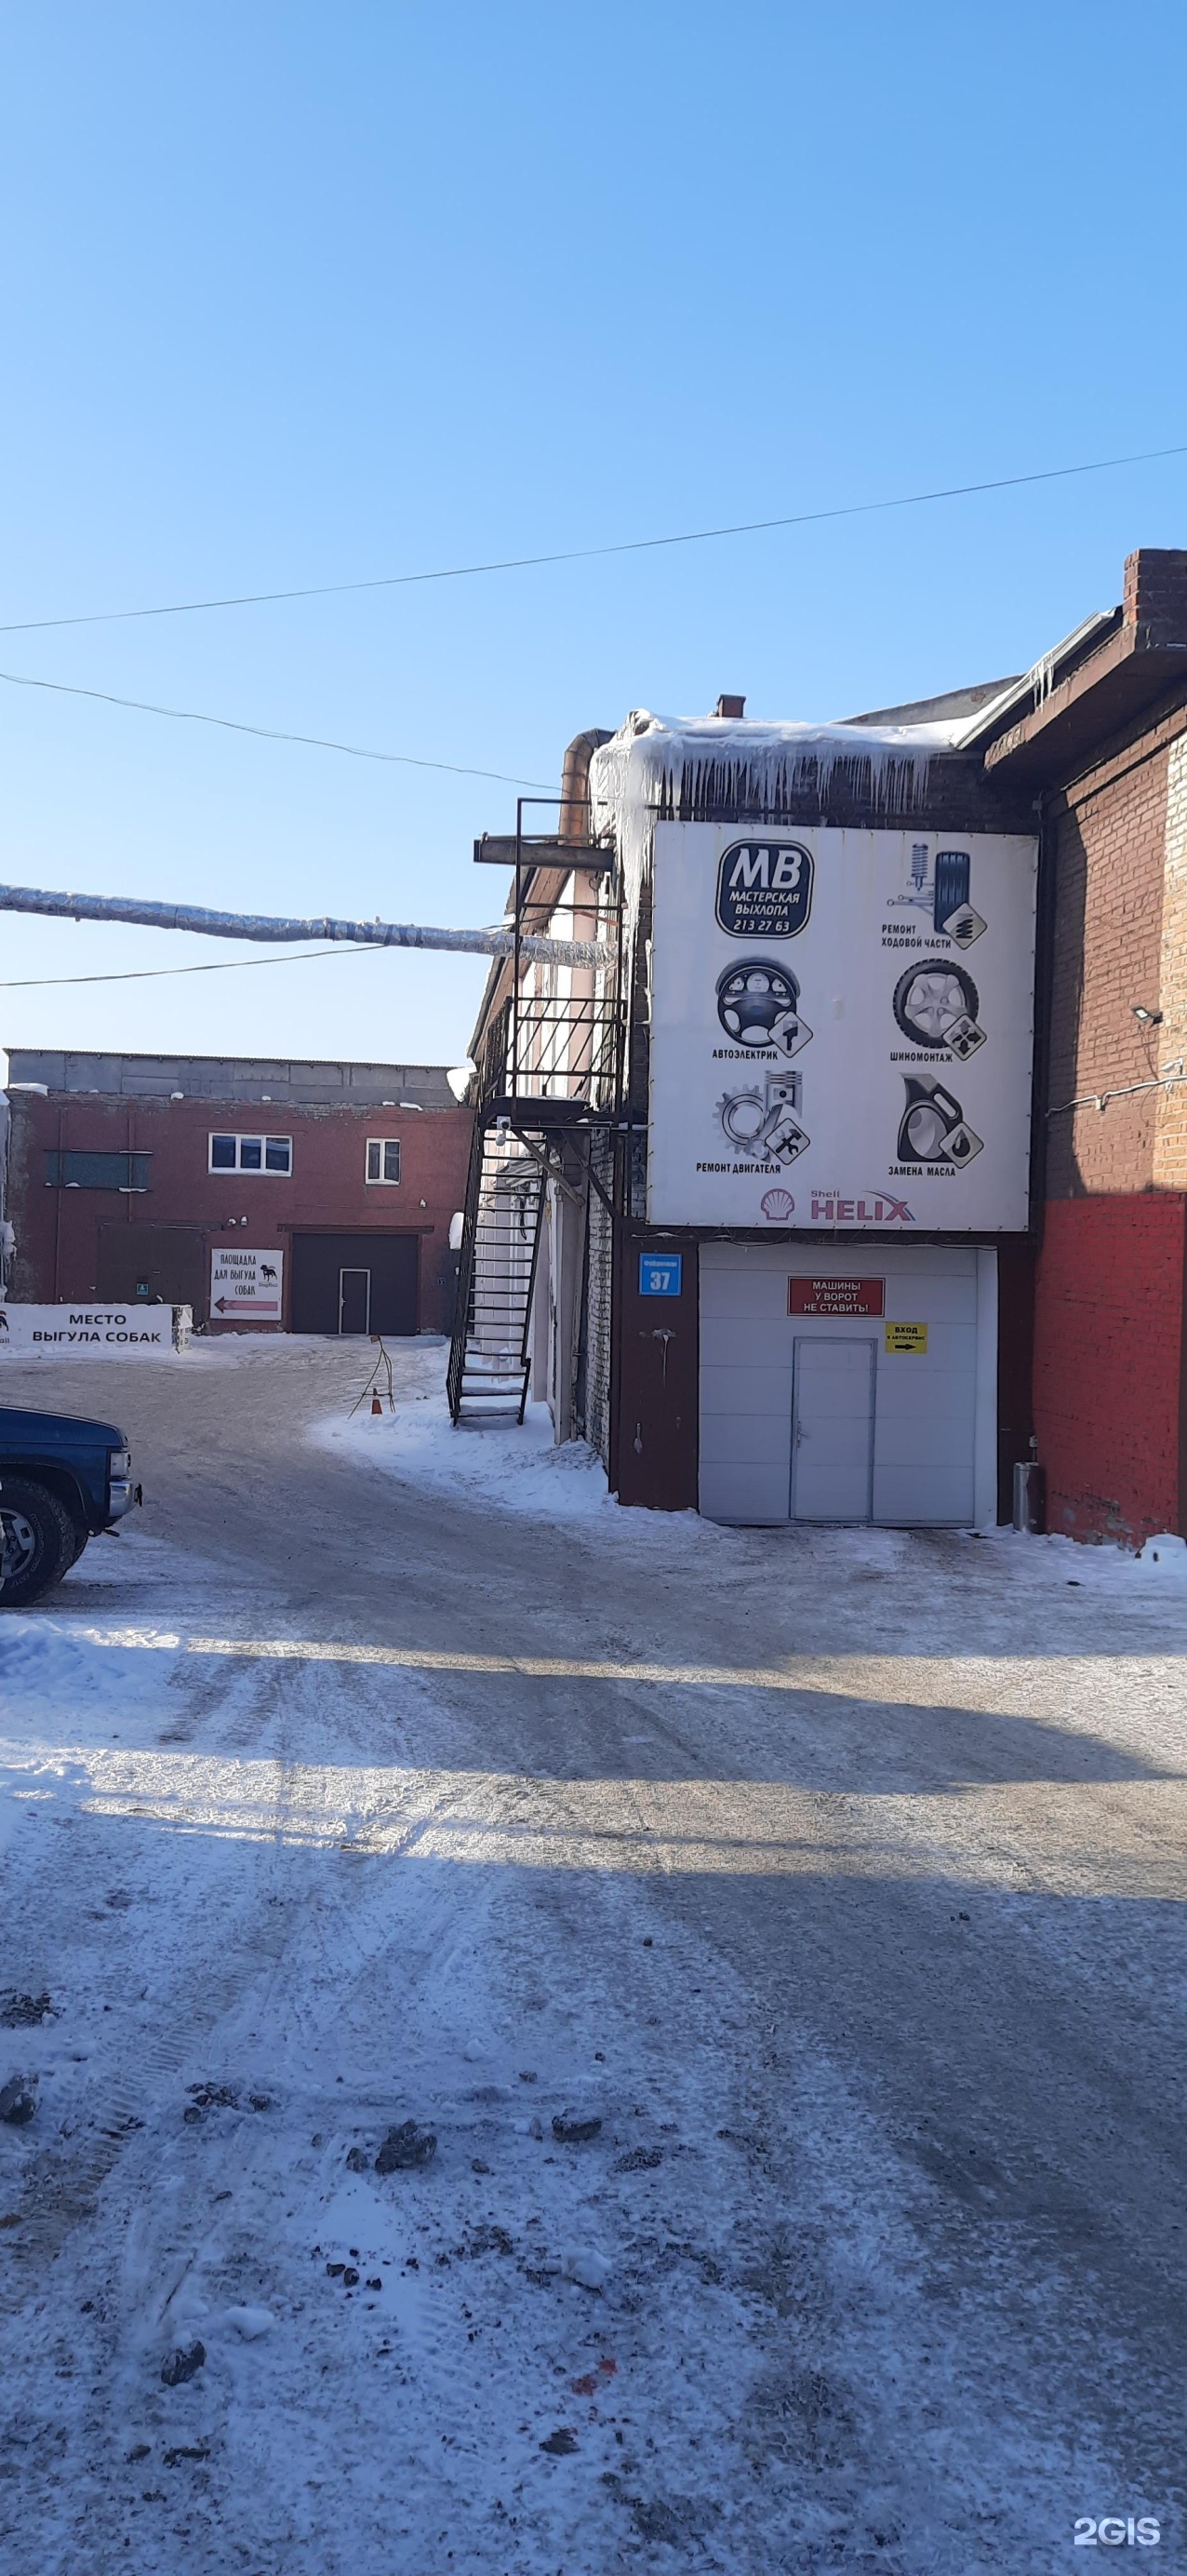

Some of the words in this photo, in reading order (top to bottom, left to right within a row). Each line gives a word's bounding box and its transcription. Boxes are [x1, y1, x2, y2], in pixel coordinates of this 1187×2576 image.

[729, 891, 800, 904] МАСТЕРСКАЯ
[735, 904, 789, 917] ВЫХЛОПА
[734, 919, 754, 930] 213
[758, 920, 772, 931] 27
[775, 920, 790, 932] 63
[882, 924, 916, 934] РЕМОНТ
[882, 935, 922, 948] ХОДОВОЙ
[925, 938, 952, 948] ЧАСТИ
[713, 1049, 779, 1060] АВТОЭЛЕКТРИК
[890, 1052, 953, 1062] ШИНОМОНТАЖ
[696, 1162, 730, 1173] РЕМОНТ
[732, 1163, 780, 1174] ДВИГАТЕЛЯ
[888, 1166, 923, 1176] ЗАМЕНА
[927, 1167, 955, 1176] МАСЛА
[811, 1200, 912, 1221] HELIX
[220, 1254, 257, 1266] ПЛОЩАДКА
[214, 1269, 228, 1280] ДЛЯ
[230, 1269, 256, 1281] ВЫГУЛА
[650, 1271, 670, 1291] 37
[812, 1281, 860, 1291] МАШИНЫ
[234, 1285, 256, 1295] СОБАК
[815, 1292, 821, 1301] У
[824, 1293, 858, 1302] ВОРОТ
[804, 1303, 817, 1312] НЕ
[820, 1303, 869, 1313] СТАВИТЬ!
[69, 1314, 127, 1325] МЕСТО
[895, 1326, 918, 1335] ВХОД
[33, 1331, 101, 1342] ВЫГУЛА
[105, 1332, 161, 1343] СОБАК
